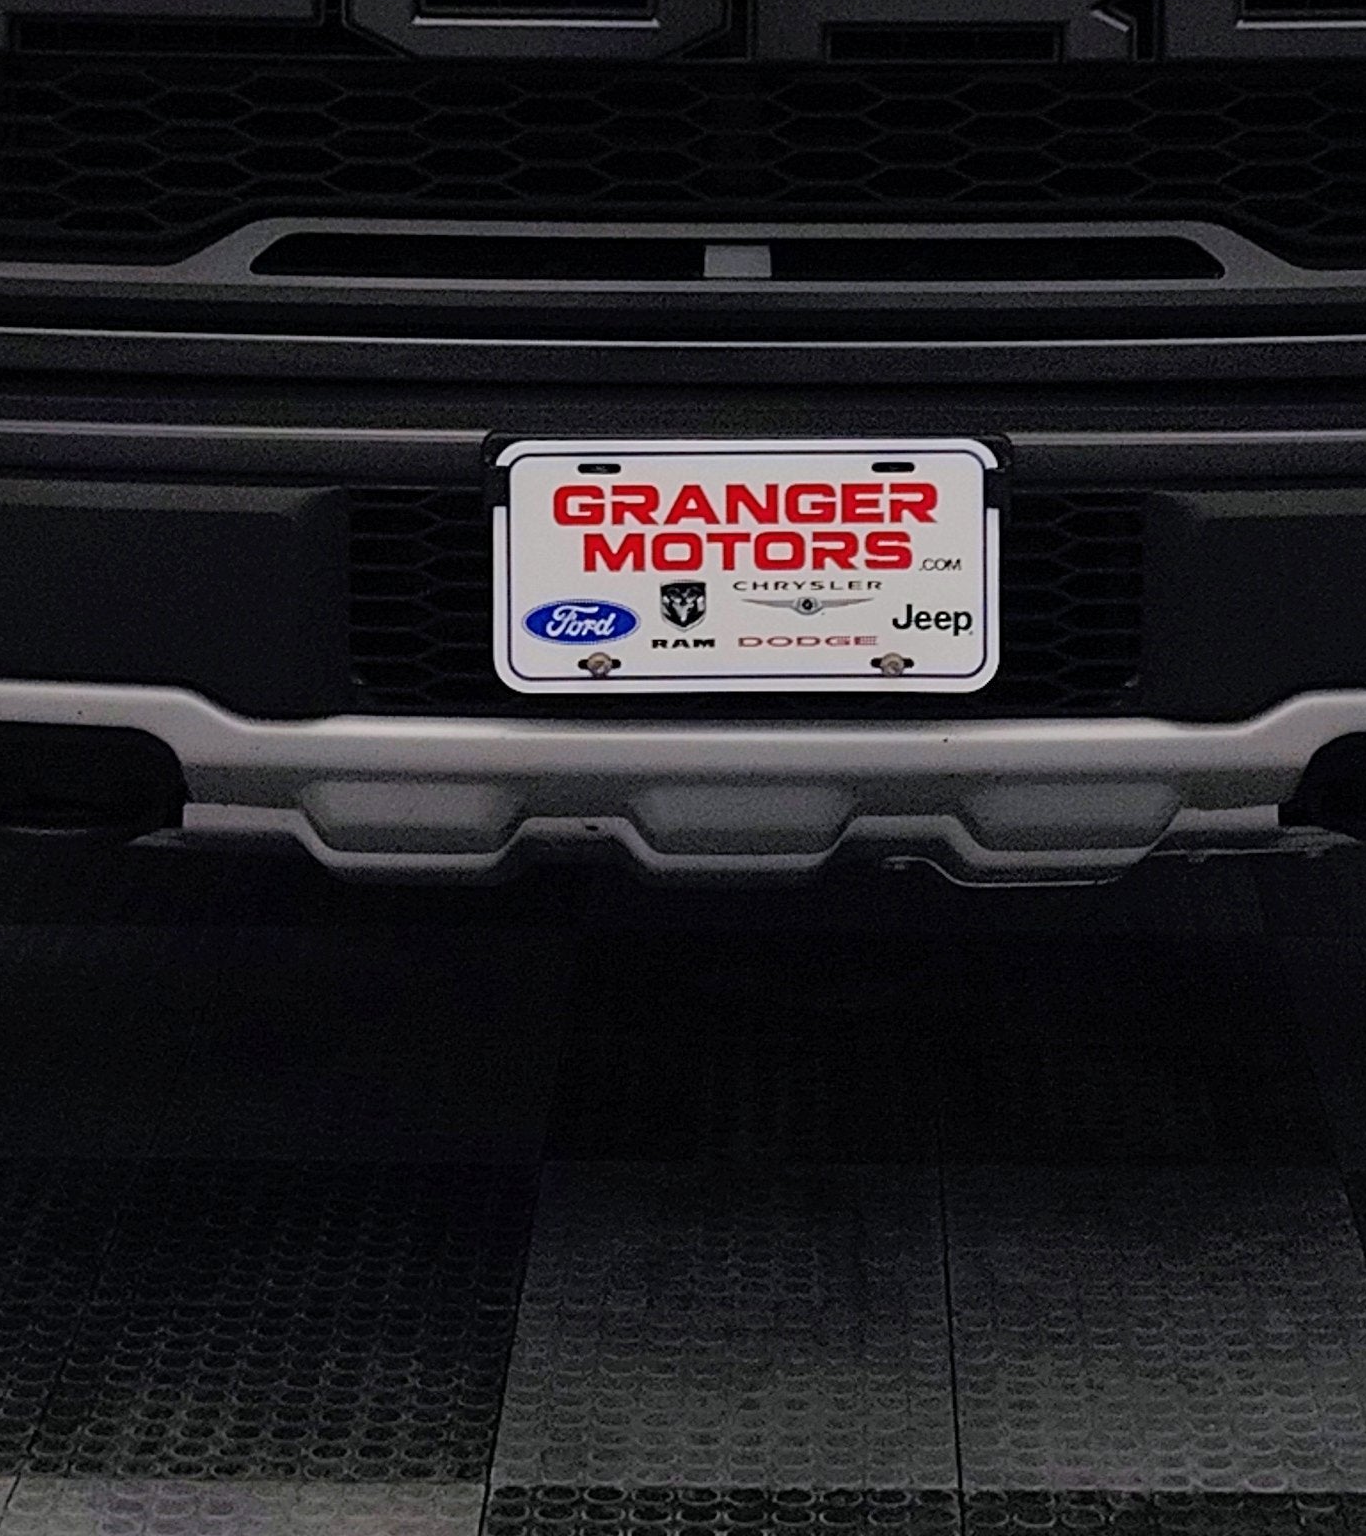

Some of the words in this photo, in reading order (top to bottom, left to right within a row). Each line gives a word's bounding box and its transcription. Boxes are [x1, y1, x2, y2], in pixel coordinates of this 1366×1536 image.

[553, 483, 939, 526] GRANGER
[583, 531, 913, 572] MOTORS
[733, 581, 883, 591] CHRYSLER
[546, 605, 617, 638] Ford
[892, 604, 973, 636] Jeep
[651, 638, 716, 649] RAM
[738, 635, 878, 648] DODGE
